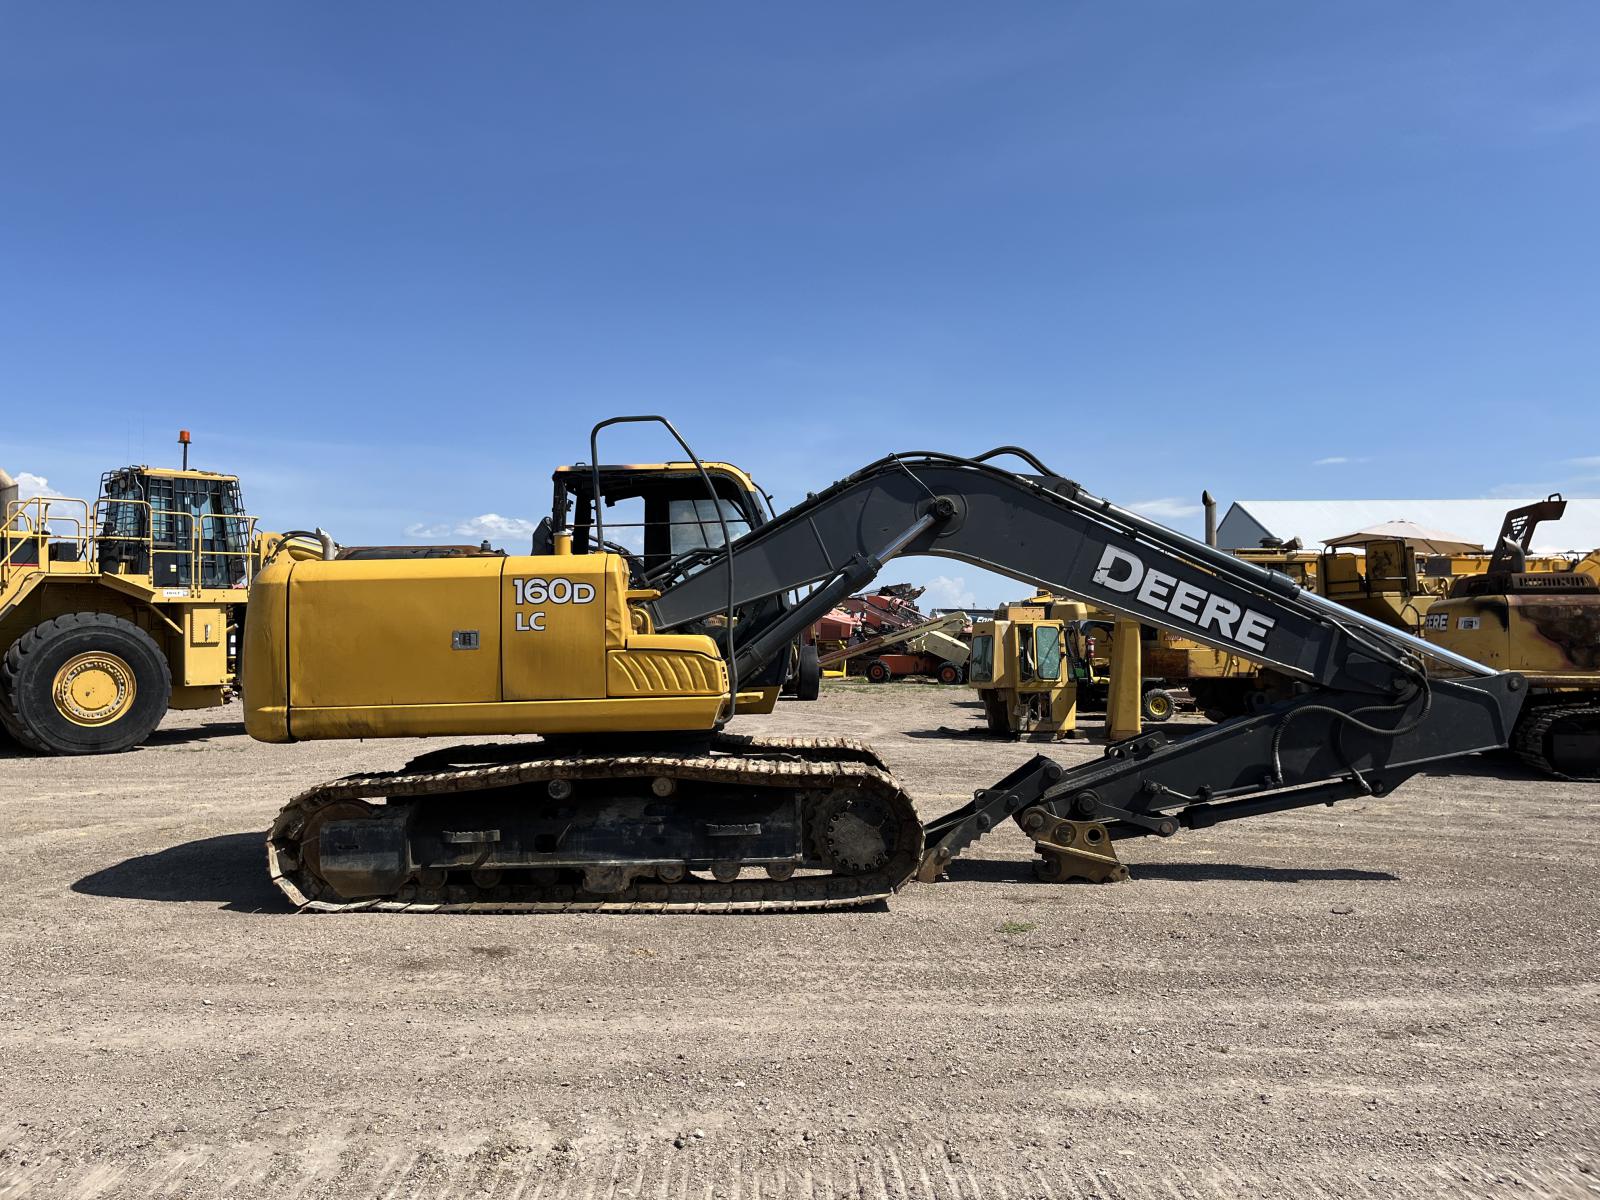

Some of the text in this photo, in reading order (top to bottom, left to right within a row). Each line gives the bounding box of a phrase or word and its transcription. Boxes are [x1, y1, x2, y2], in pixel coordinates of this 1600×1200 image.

[513, 578, 596, 605] 160D
[1092, 544, 1276, 652] DEERE
[515, 611, 546, 631] LC
